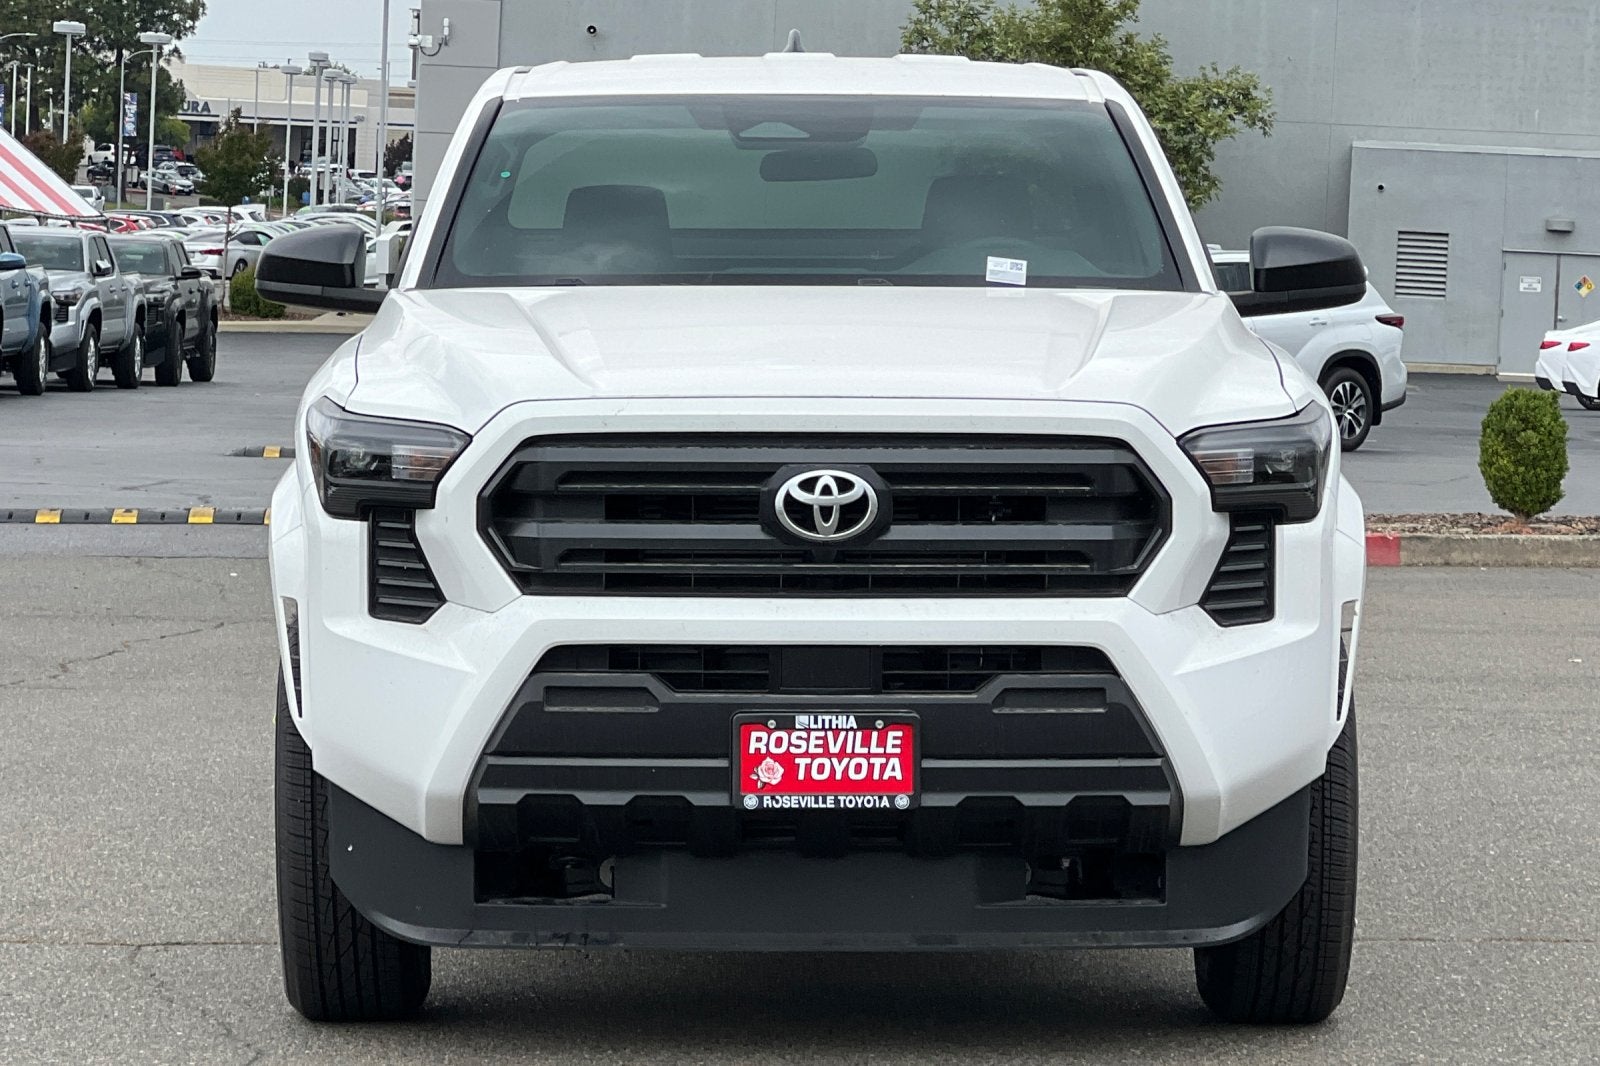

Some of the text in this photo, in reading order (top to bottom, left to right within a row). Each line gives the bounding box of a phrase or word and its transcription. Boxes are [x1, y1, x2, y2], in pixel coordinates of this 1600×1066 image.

[810, 715, 857, 729] LITHIA
[749, 730, 903, 754] ROSEVILLE
[795, 757, 903, 781] TOYOTA
[763, 796, 890, 808] ROSEVILLE TOYOTA
